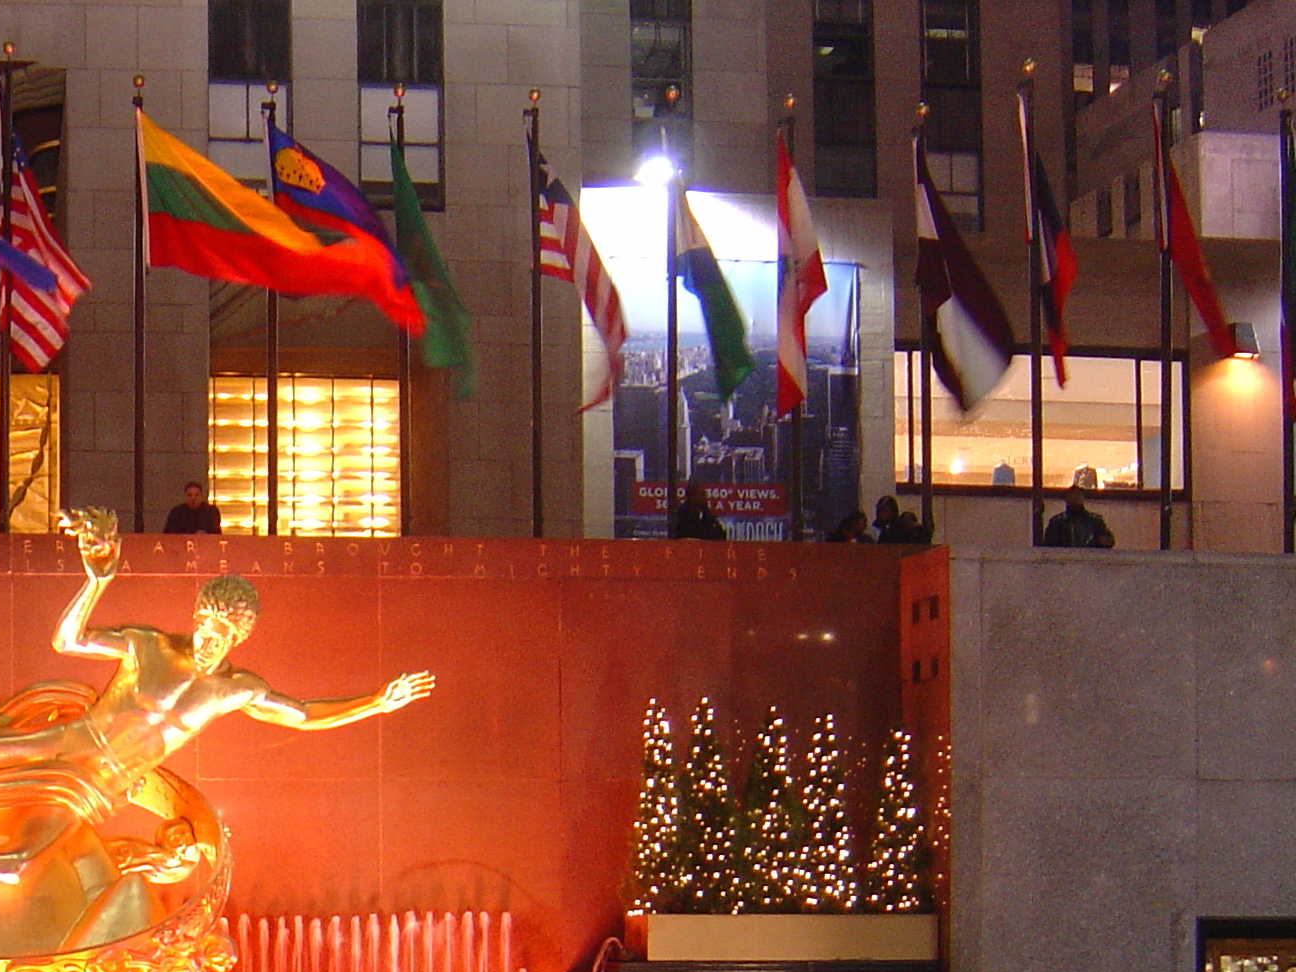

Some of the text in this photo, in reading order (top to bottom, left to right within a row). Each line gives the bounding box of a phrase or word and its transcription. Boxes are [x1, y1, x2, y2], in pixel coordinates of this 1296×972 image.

[737, 489, 780, 499] VIEWS.
[715, 501, 725, 510] A
[728, 501, 764, 511] YEAR.
[153, 541, 228, 554] ART
[538, 544, 610, 559] THE
[665, 546, 767, 561] FIRE
[186, 561, 326, 574] MEANS
[380, 561, 423, 575] TO
[697, 565, 797, 580] ENDS
